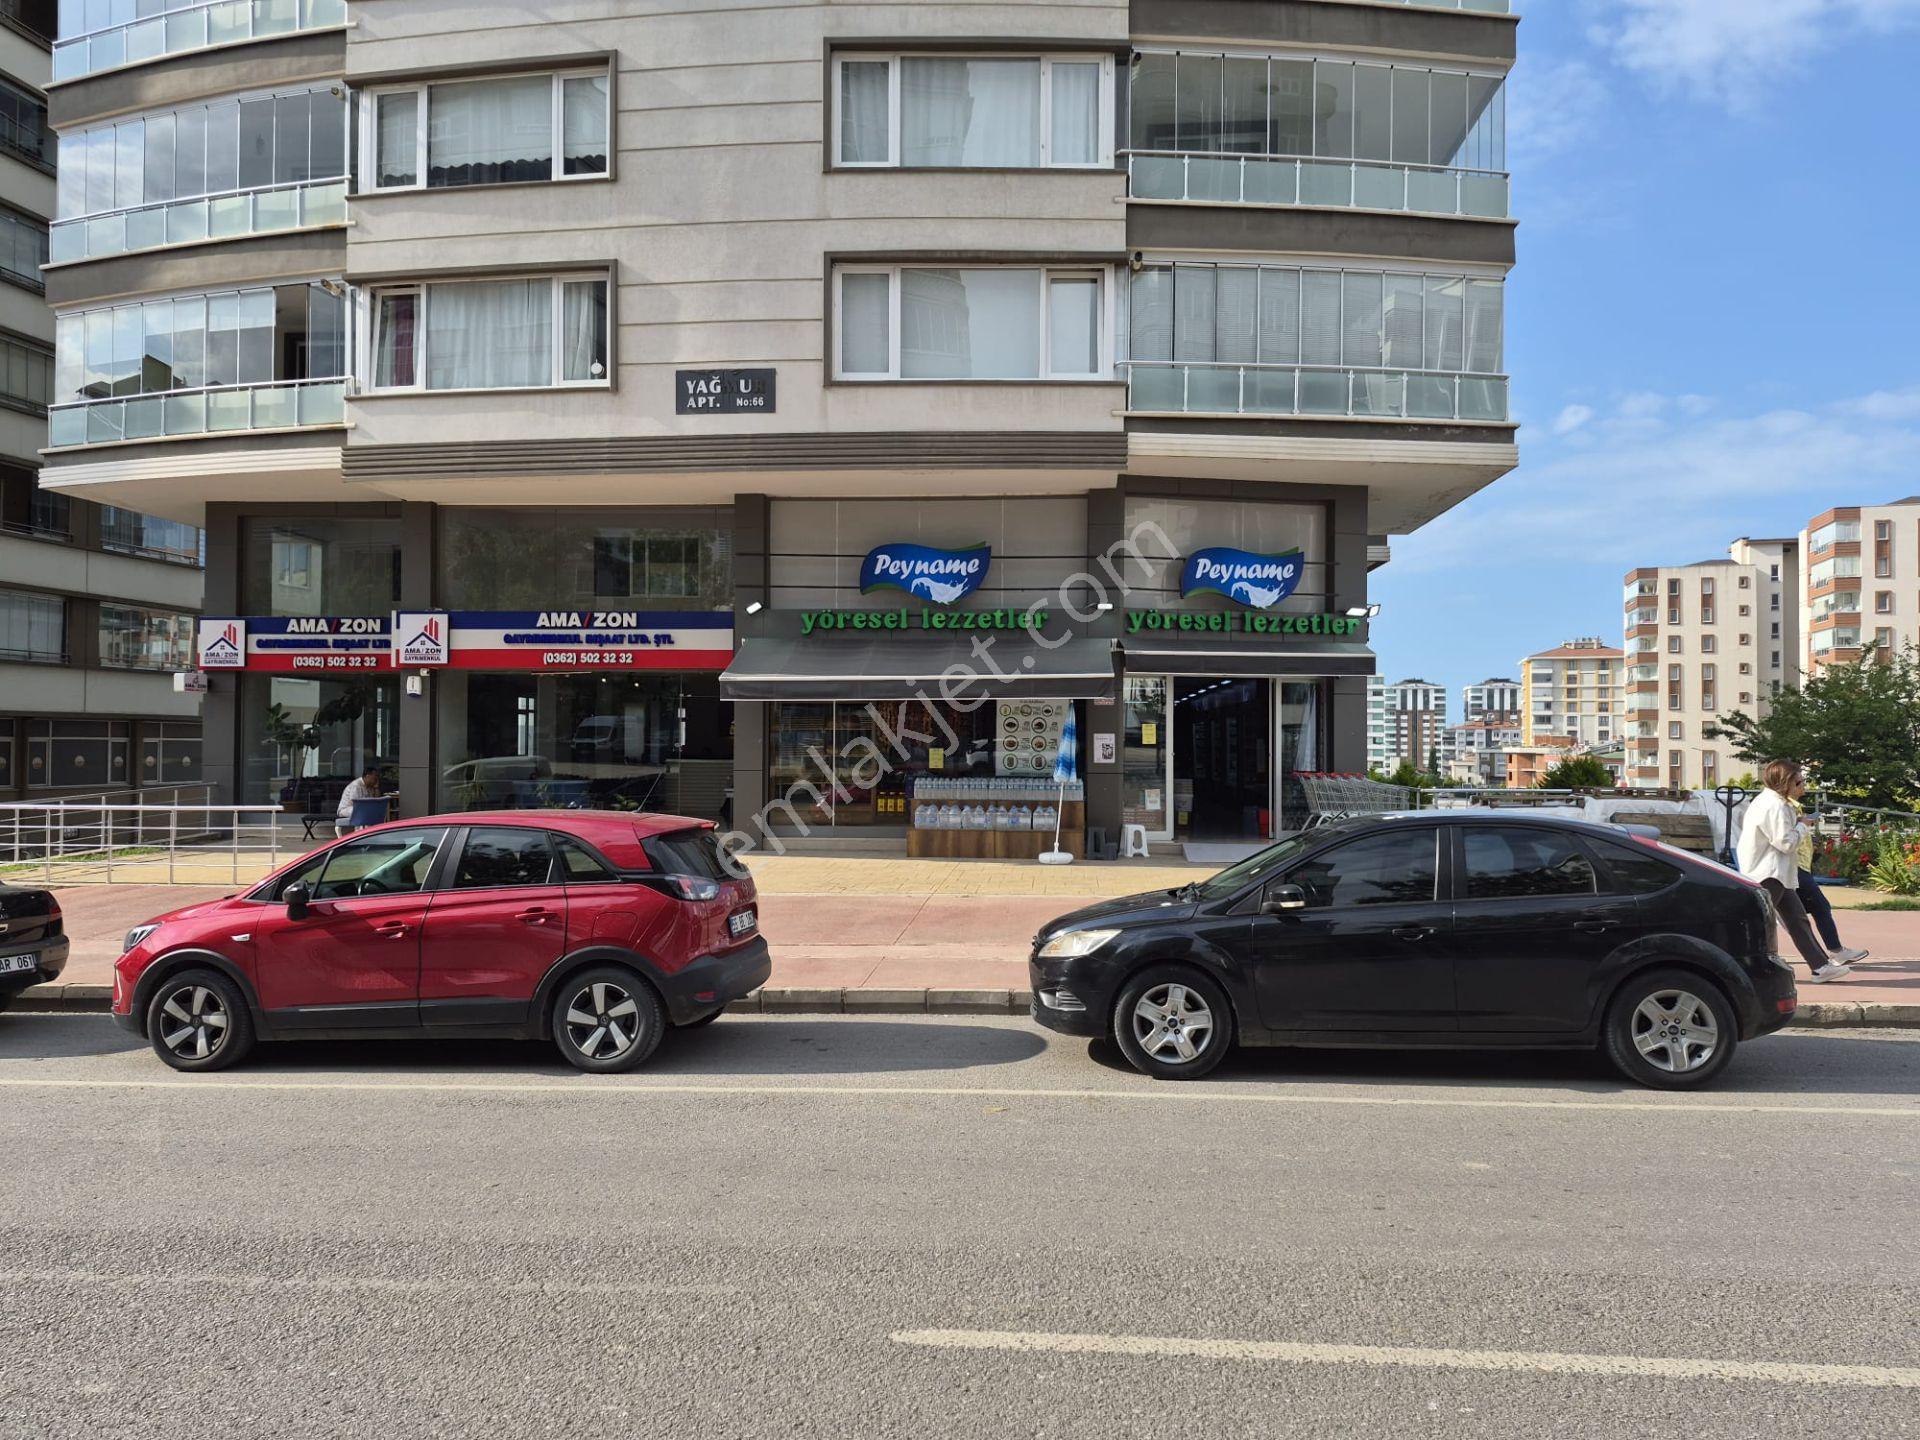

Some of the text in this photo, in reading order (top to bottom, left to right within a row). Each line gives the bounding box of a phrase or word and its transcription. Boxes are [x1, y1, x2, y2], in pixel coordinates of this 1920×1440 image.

[687, 396, 764, 408] APT. No:66
[874, 554, 980, 579] Peyname
[1195, 558, 1295, 584] Peyname
[801, 608, 1048, 634] yöresel lezzetler
[1128, 609, 1360, 635] yöresel lezzetler
[293, 656, 376, 668] (0362) 502 32 32
[543, 652, 632, 665] (0362) 502 32 32
[17, 955, 33, 968] 061
